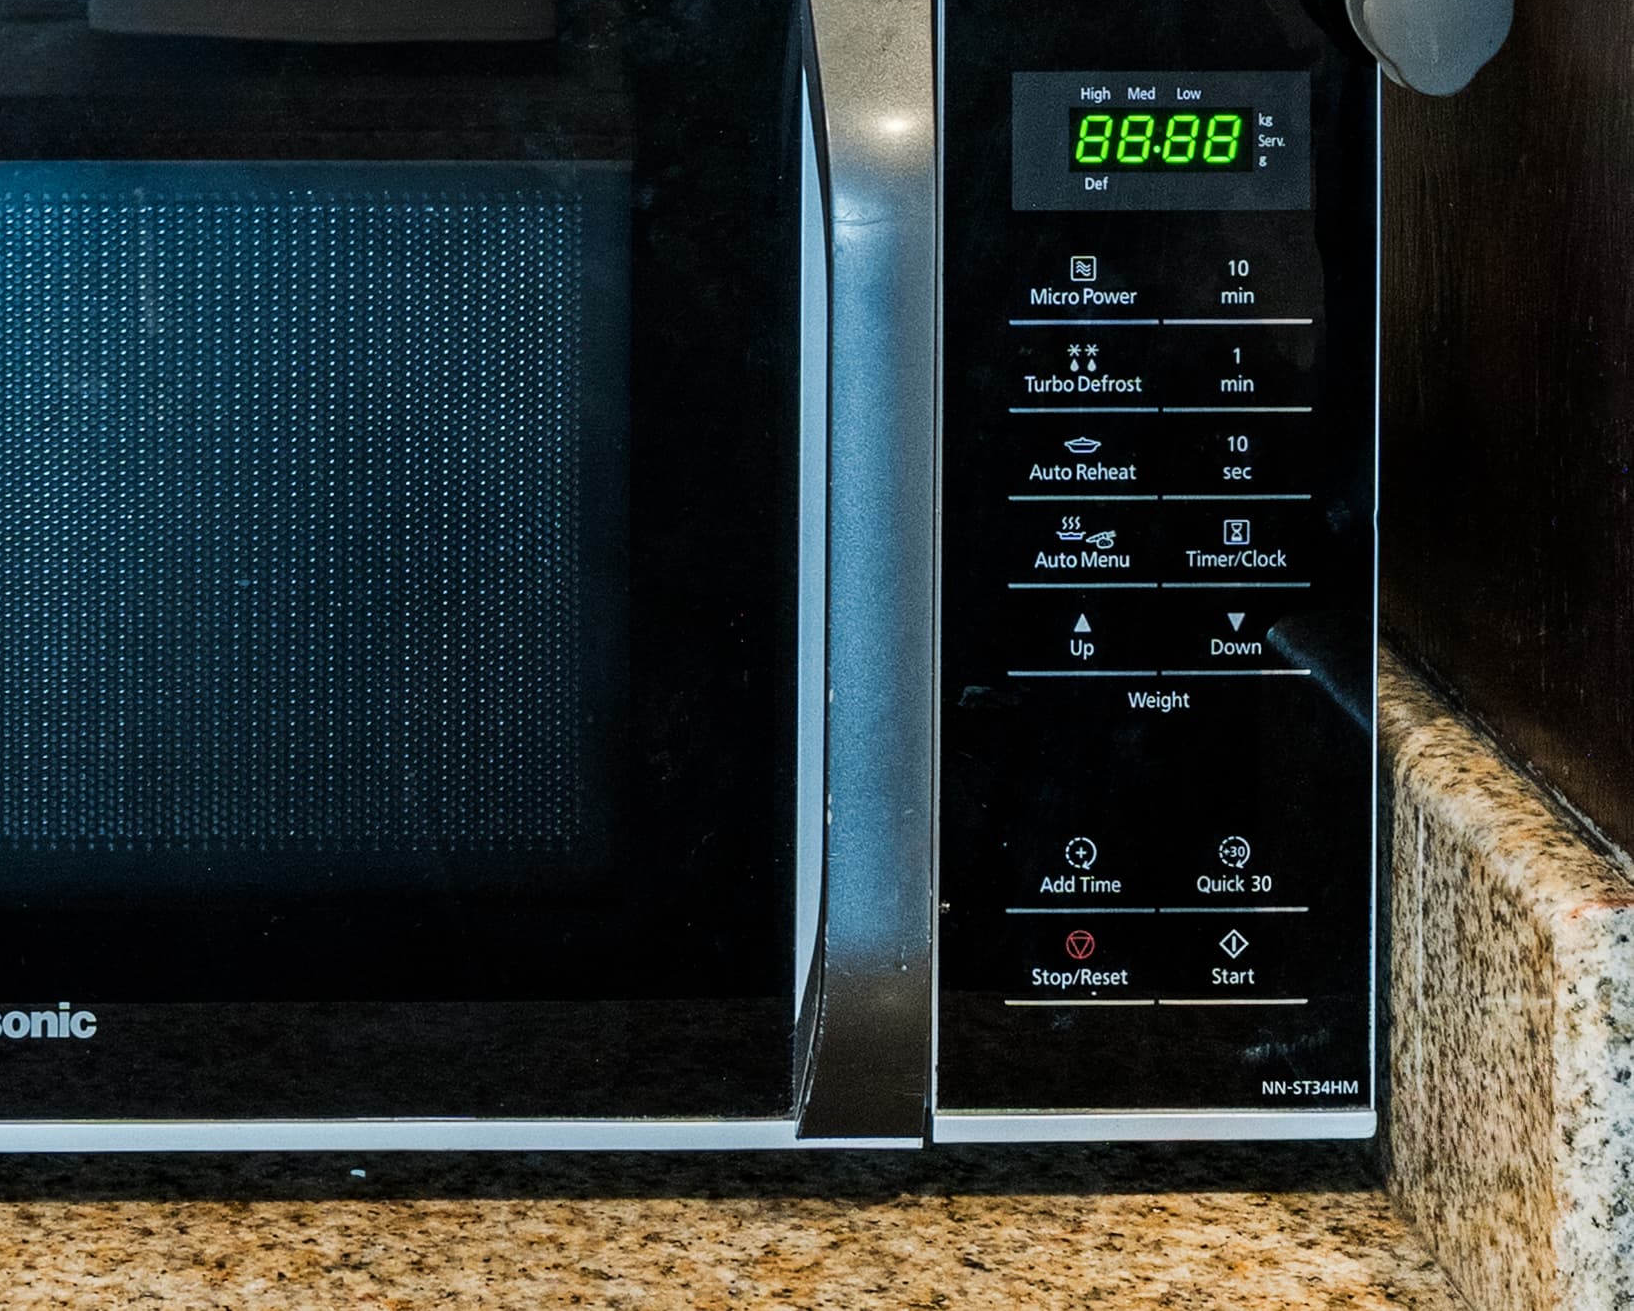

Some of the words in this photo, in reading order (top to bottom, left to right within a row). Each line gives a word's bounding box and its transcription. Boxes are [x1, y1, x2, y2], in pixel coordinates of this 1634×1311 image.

[1080, 86, 1111, 104] High
[1127, 86, 1156, 101] Med
[1176, 87, 1202, 100] Low
[1258, 112, 1274, 128] kg
[1258, 133, 1286, 148] Serv.
[1258, 155, 1268, 168] g
[1084, 176, 1109, 191] Def
[1228, 259, 1250, 277] 10
[1030, 287, 1080, 306] Micro
[1082, 287, 1138, 305] Power
[1221, 286, 1255, 304] min
[1233, 347, 1241, 365] 1
[1024, 374, 1075, 393] Turbo
[1077, 374, 1143, 393] Defrost
[1220, 374, 1255, 392] min
[1227, 435, 1249, 453] 10
[1029, 463, 1073, 481] Auto
[1076, 461, 1137, 481] Reheat
[1223, 466, 1252, 480] sec
[1034, 551, 1078, 569] Auto
[1081, 551, 1131, 570] Menu
[1185, 549, 1287, 568] Timer/Clock
[1070, 639, 1095, 661] Up
[1210, 638, 1262, 656] Down
[1127, 690, 1190, 713] Weight
[1039, 875, 1076, 893] Add
[1079, 875, 1122, 893] Time
[1196, 874, 1245, 894] Quick
[1251, 875, 1272, 893] 30
[1031, 968, 1129, 988] Stop/Reset
[1211, 967, 1255, 985] Start
[1262, 1080, 1359, 1095] NN-ST34HM
